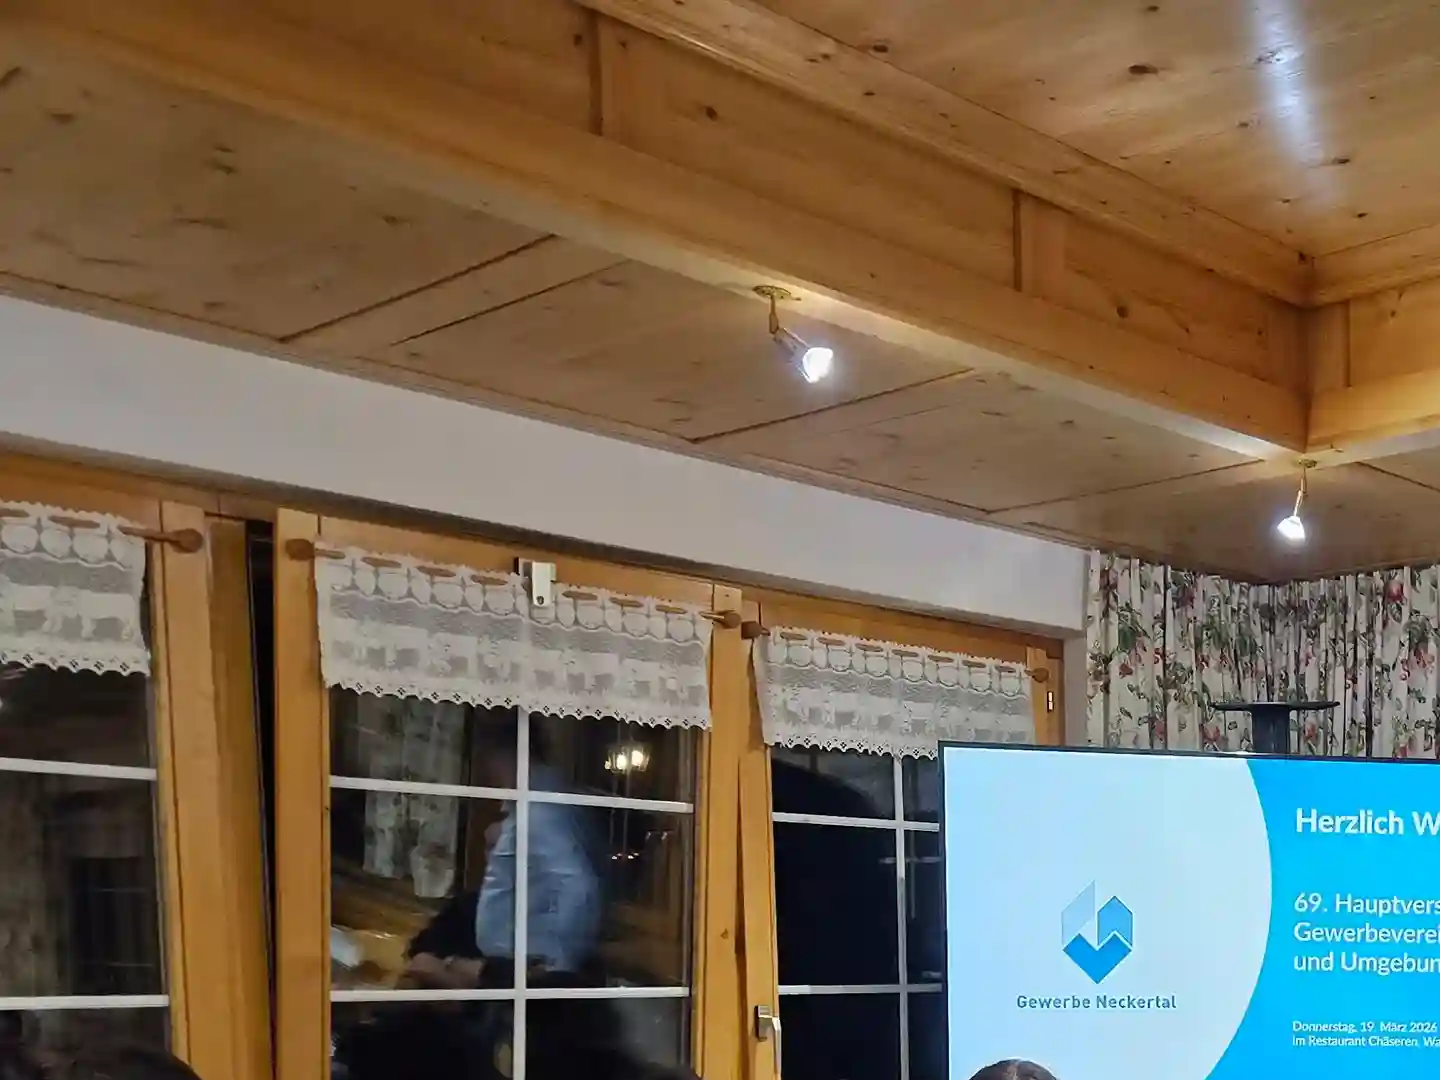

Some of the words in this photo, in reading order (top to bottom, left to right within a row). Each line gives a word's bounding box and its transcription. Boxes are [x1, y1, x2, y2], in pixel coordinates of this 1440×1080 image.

[1295, 807, 1404, 835] Herzlich
[1293, 892, 1328, 913] 69.
[1293, 952, 1334, 972] und
[1016, 995, 1091, 1009] Gewerbe
[1096, 994, 1177, 1009] Neckertal
[1292, 1020, 1358, 1034] Donnerstag,
[1380, 1021, 1407, 1033] März
[1409, 1022, 1438, 1033] 2026
[1308, 1035, 1366, 1047] Restaurant
